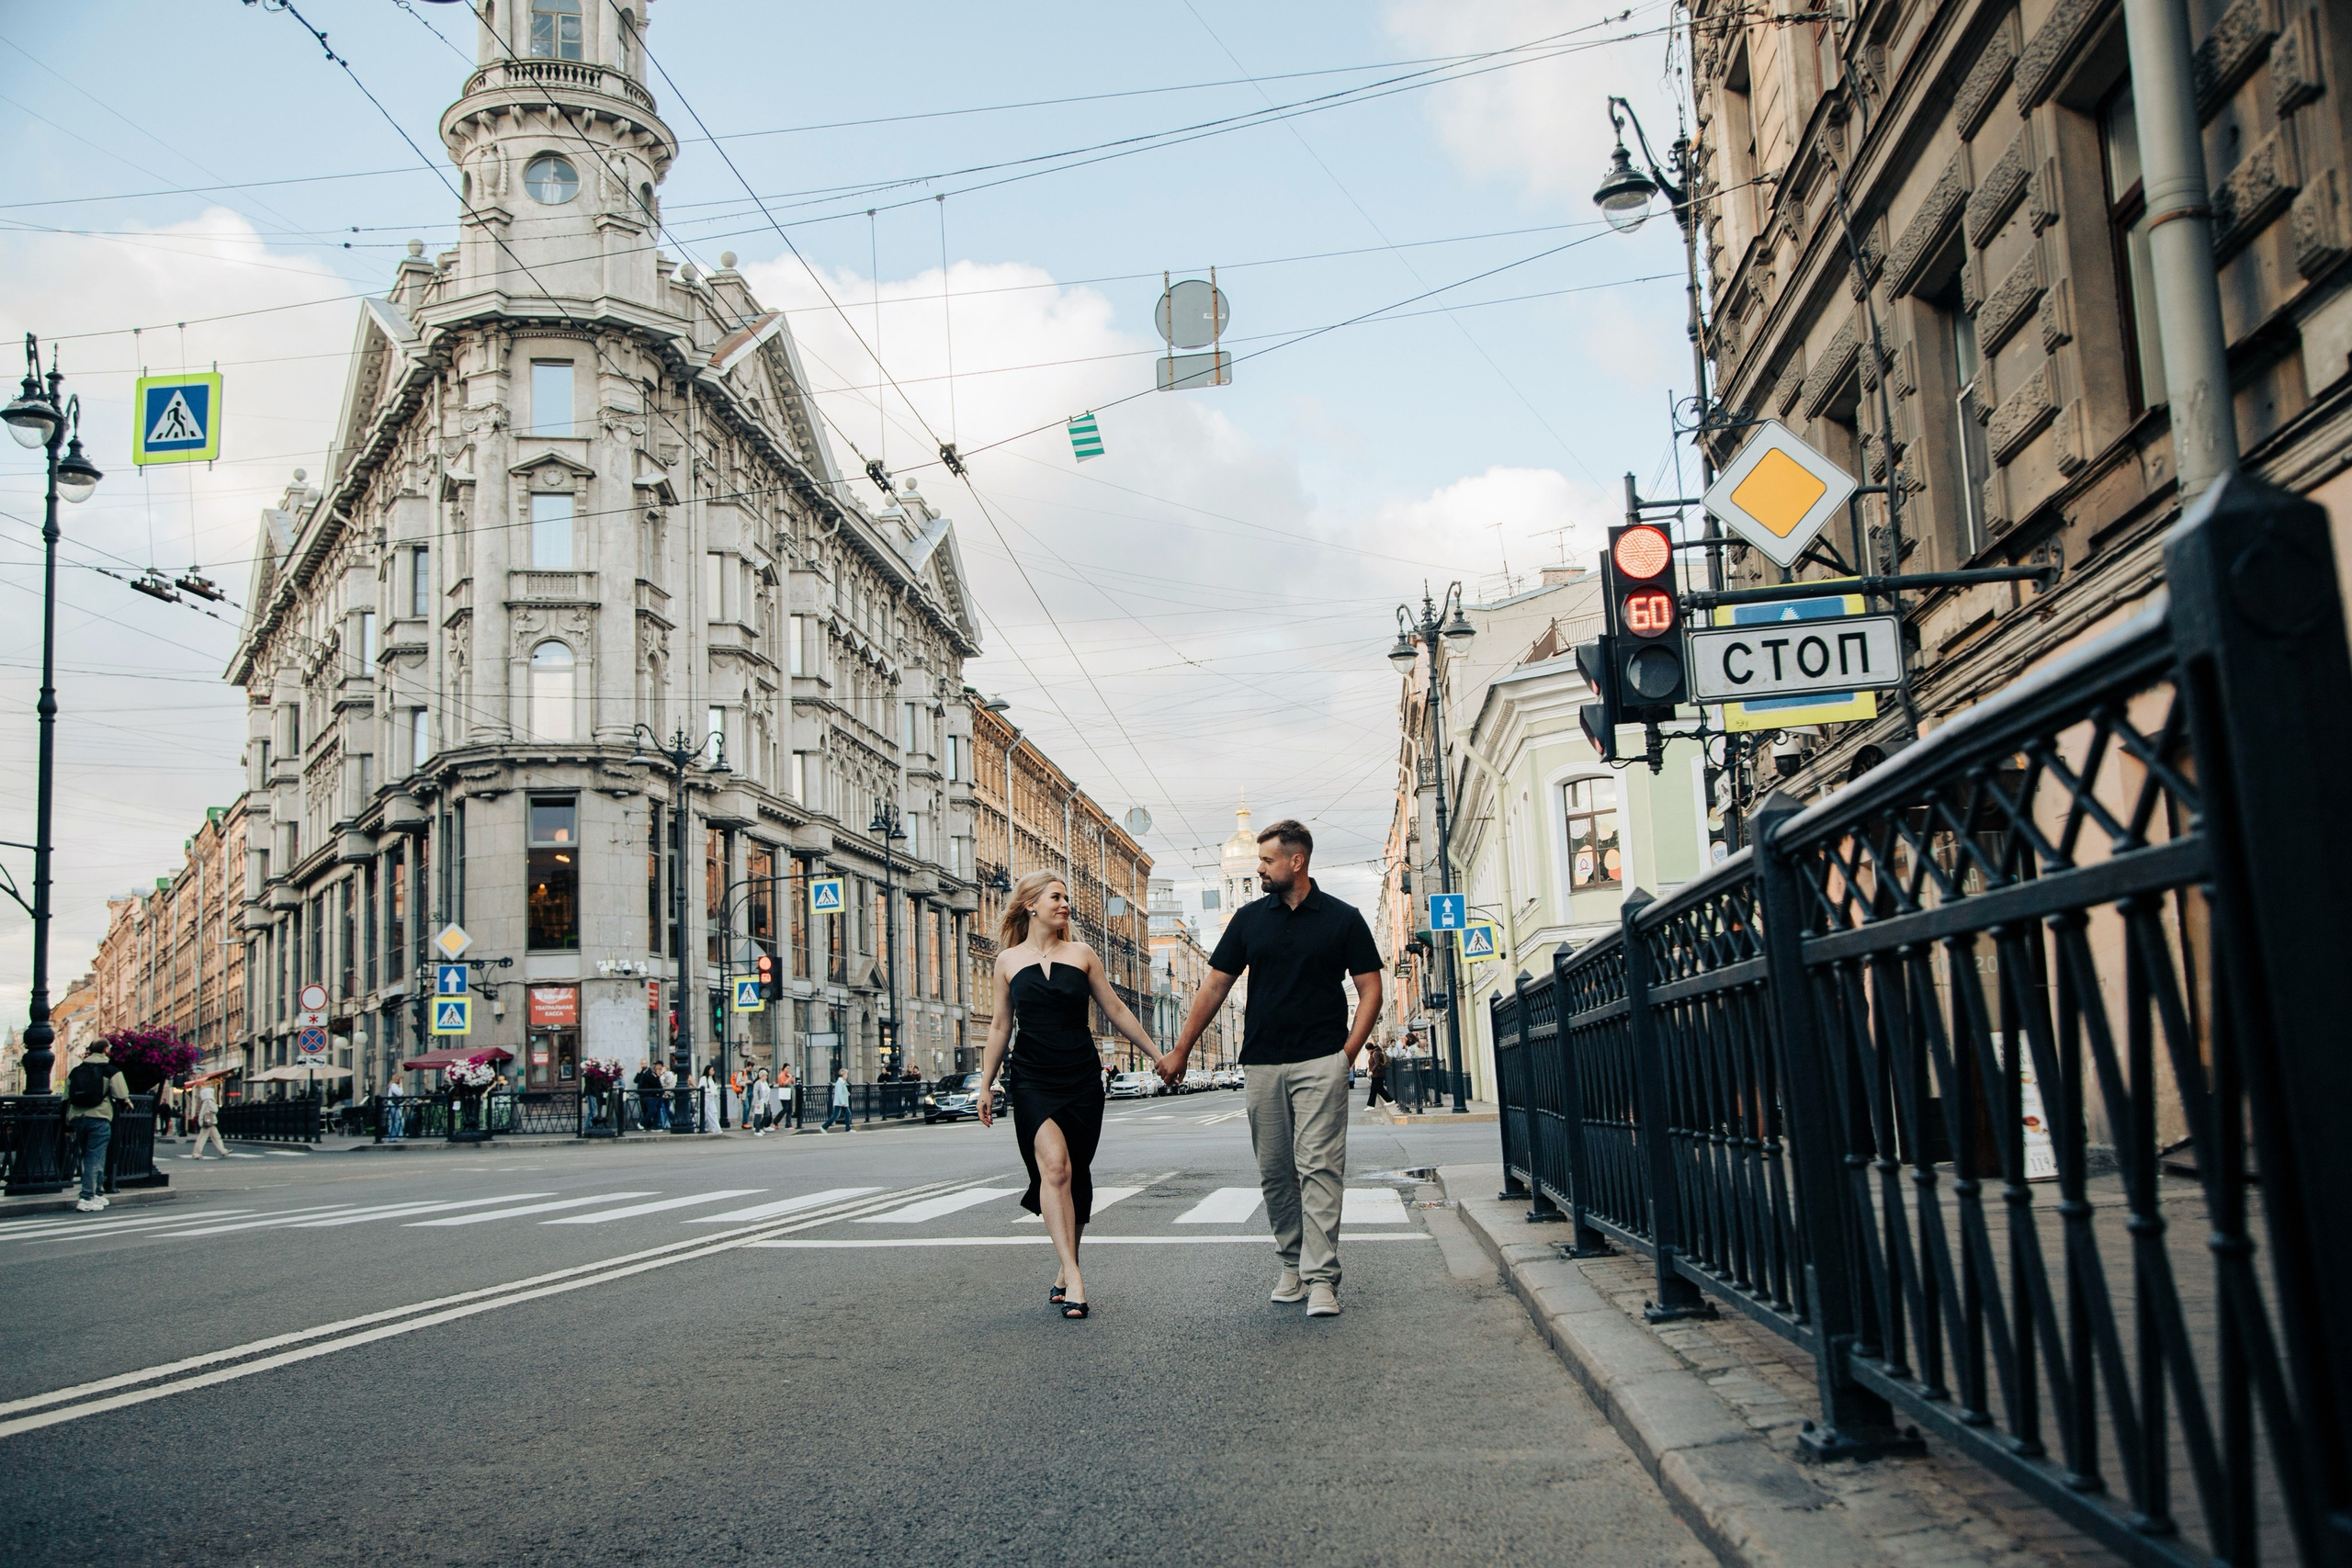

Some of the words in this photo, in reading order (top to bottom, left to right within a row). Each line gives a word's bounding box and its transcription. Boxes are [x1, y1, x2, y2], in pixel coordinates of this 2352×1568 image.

[1630, 595, 1670, 630] 60
[1723, 631, 1870, 685] СТОП
[761, 973, 772, 983] 60
